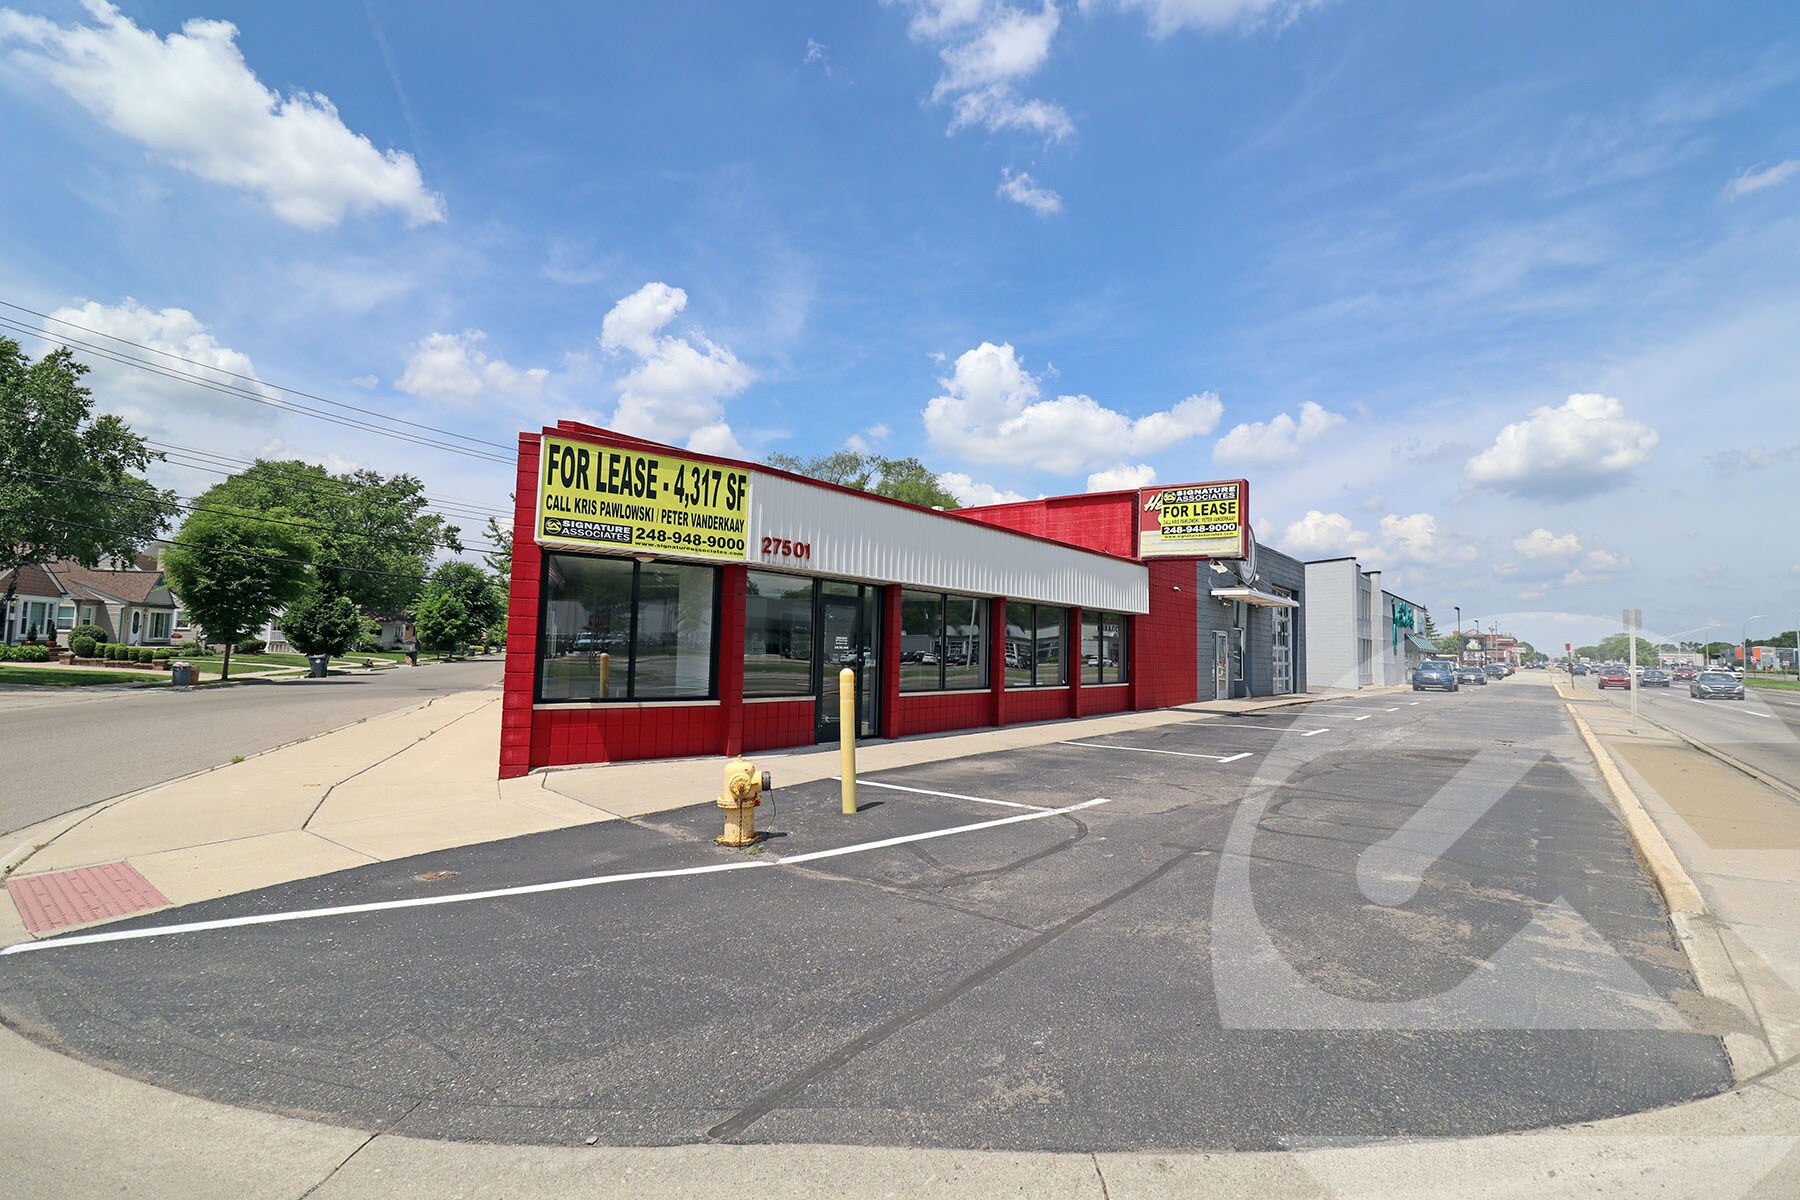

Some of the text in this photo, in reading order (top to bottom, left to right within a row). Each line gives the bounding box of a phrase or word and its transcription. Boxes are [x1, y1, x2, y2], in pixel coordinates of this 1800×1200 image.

[547, 444, 747, 511] FOR LEASE - 4,317 SF
[1176, 486, 1236, 496] SIGNATURE
[1176, 492, 1236, 502] ASSOCIATES
[546, 494, 571, 512] CALL
[574, 498, 597, 515] KRIS
[600, 501, 654, 522] PAWLOWSKI
[661, 509, 688, 526] PETER
[691, 513, 744, 533] VANDERKAAY
[1163, 502, 1236, 518] FOR LEASE
[561, 528, 631, 541] ASSOCIATES
[562, 520, 631, 534] SIGNATURE
[1163, 523, 1236, 534] 248-948-9000
[635, 527, 745, 550] 248-948-9000
[635, 541, 744, 556] www.signatureassociates.com
[761, 536, 811, 560] 27501
